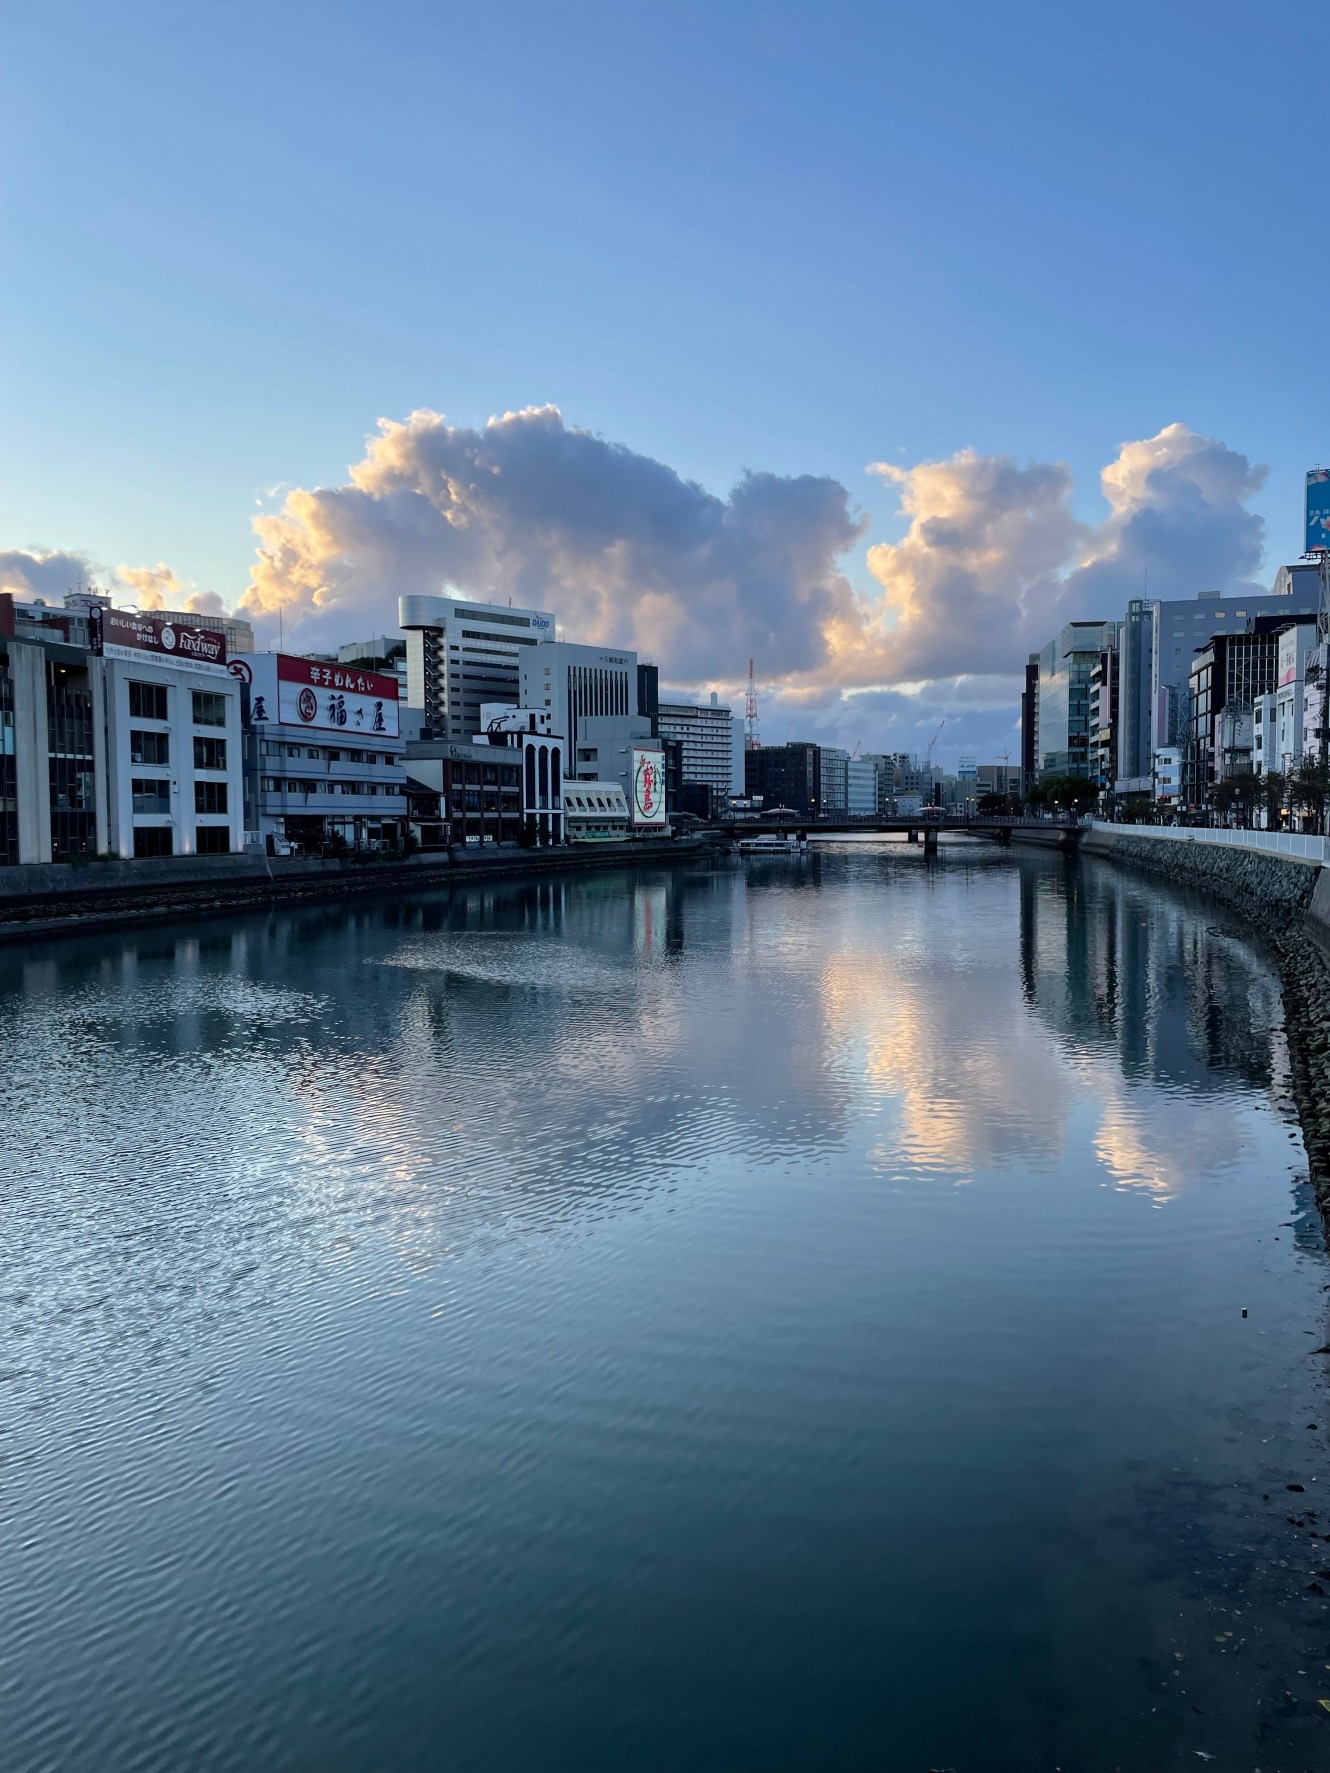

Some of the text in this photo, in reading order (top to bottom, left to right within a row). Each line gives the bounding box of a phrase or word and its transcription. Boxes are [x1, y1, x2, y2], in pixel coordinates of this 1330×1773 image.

[309, 665, 374, 692] 辛子めんたい
[327, 694, 387, 732] 福さ屋
